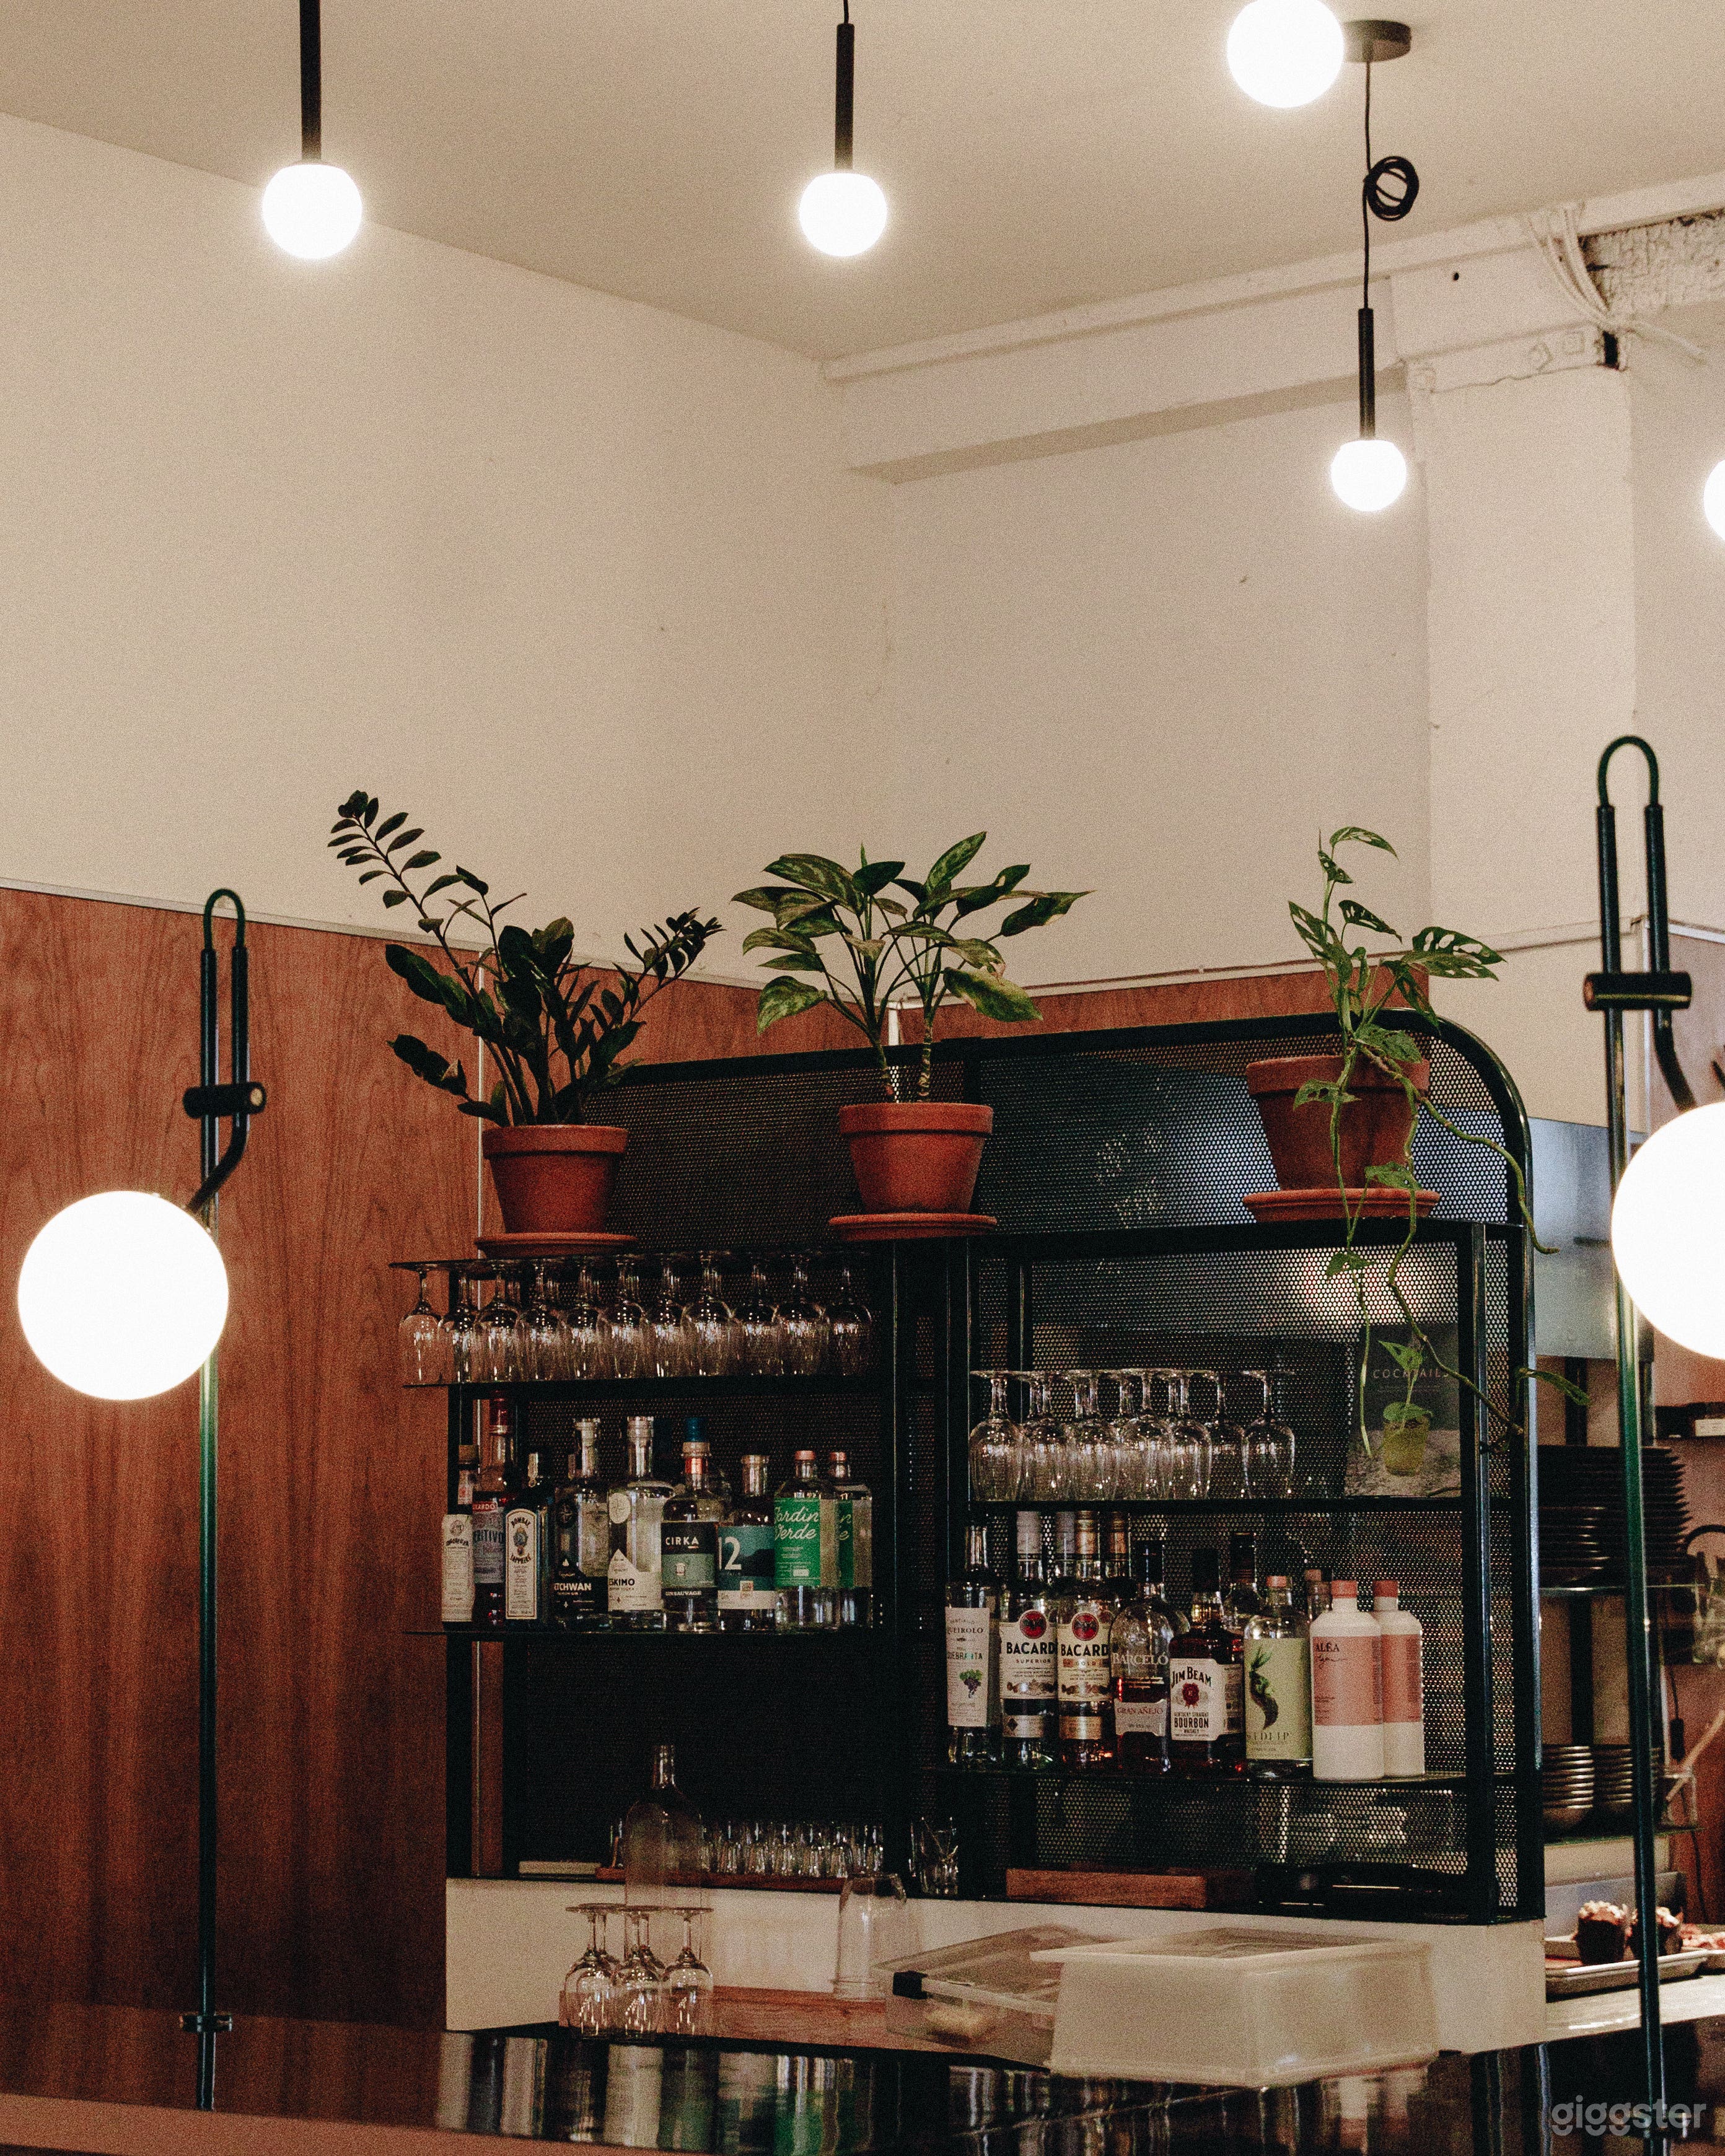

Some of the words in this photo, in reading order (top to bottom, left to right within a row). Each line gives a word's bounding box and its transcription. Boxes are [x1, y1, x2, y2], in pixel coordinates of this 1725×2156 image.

[1372, 1367, 1449, 1379] COCKAIL
[665, 1536, 700, 1546] CIRKA
[1171, 1669, 1186, 1689] JIM
[1187, 1665, 1213, 1688] BEAM
[1174, 1717, 1209, 1729] BOURBON
